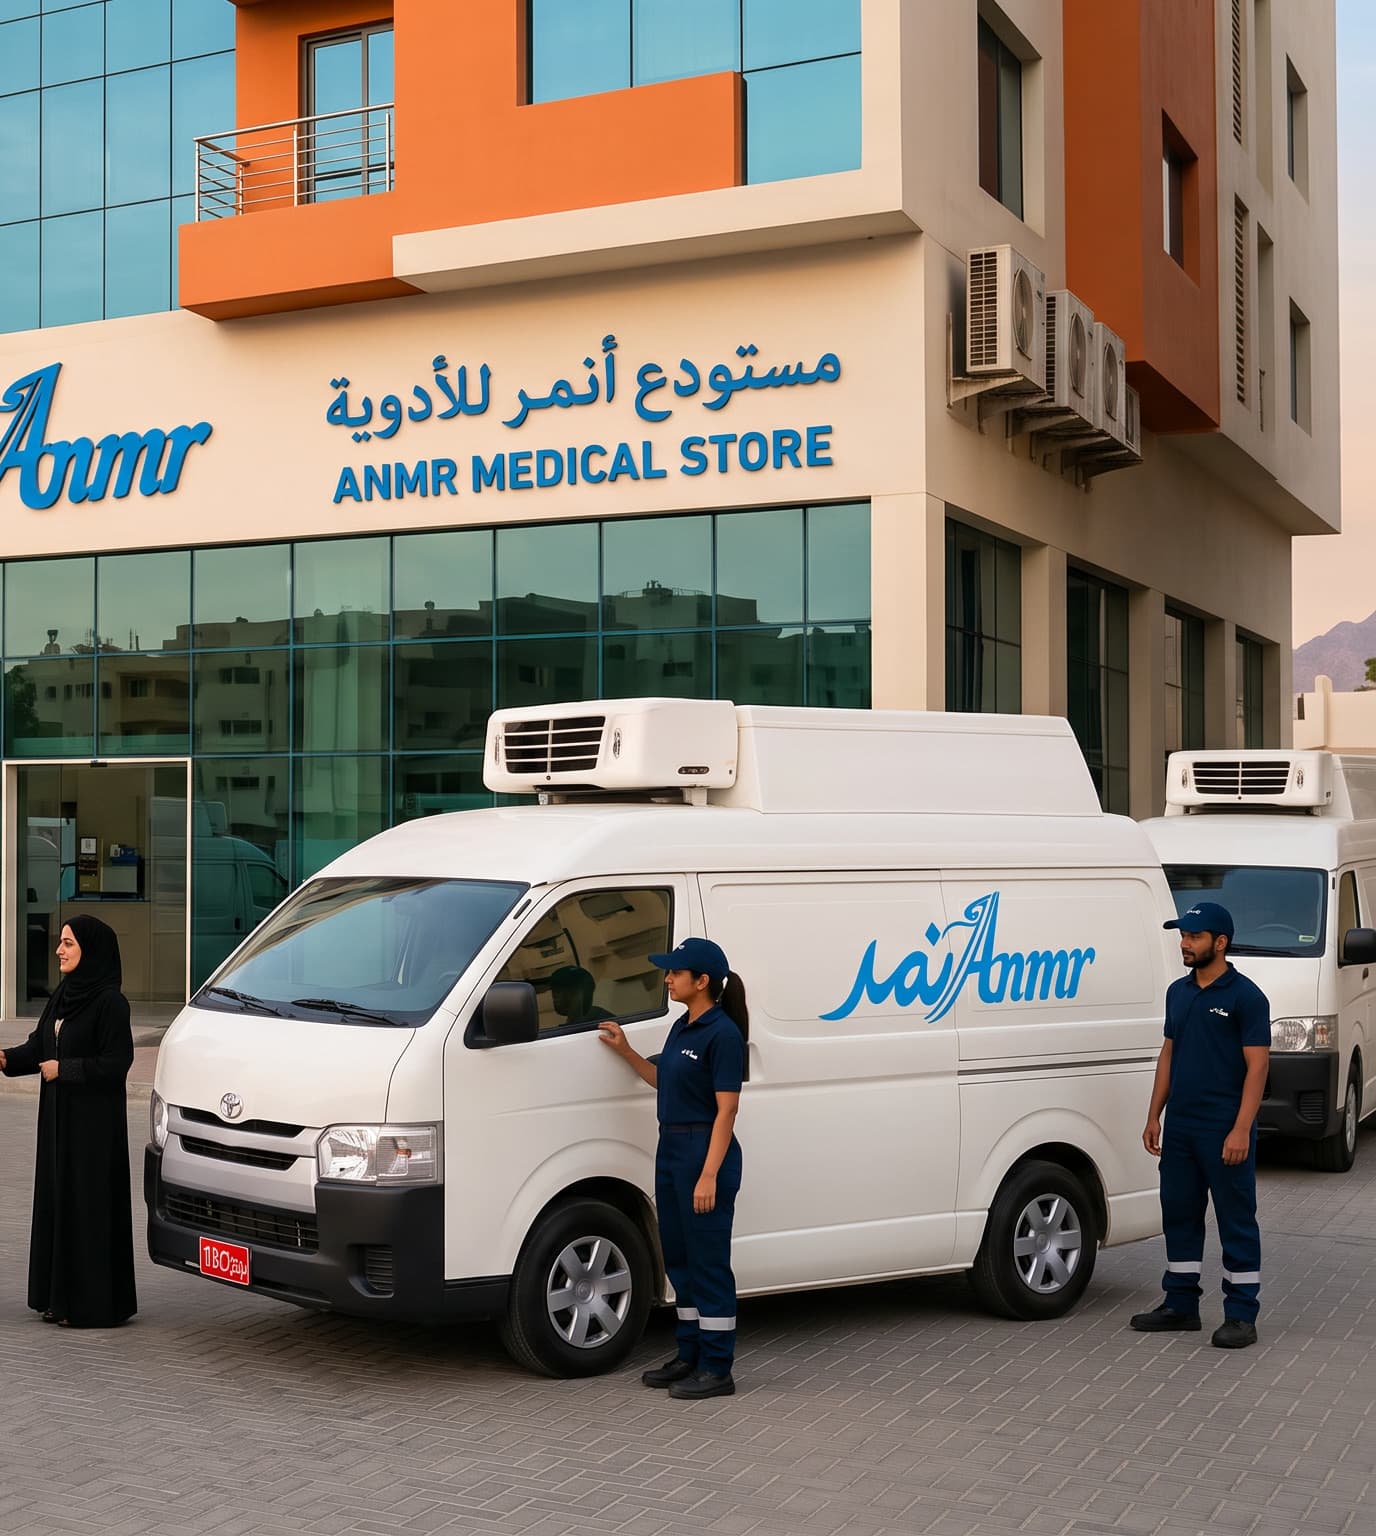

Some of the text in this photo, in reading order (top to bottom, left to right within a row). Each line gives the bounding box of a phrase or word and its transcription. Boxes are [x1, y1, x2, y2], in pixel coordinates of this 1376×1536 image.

[325, 334, 841, 443] مستودع أنمر للأدوية
[332, 424, 834, 504] ANMR MEDICAL STORE
[925, 890, 1096, 1024] Anmr
